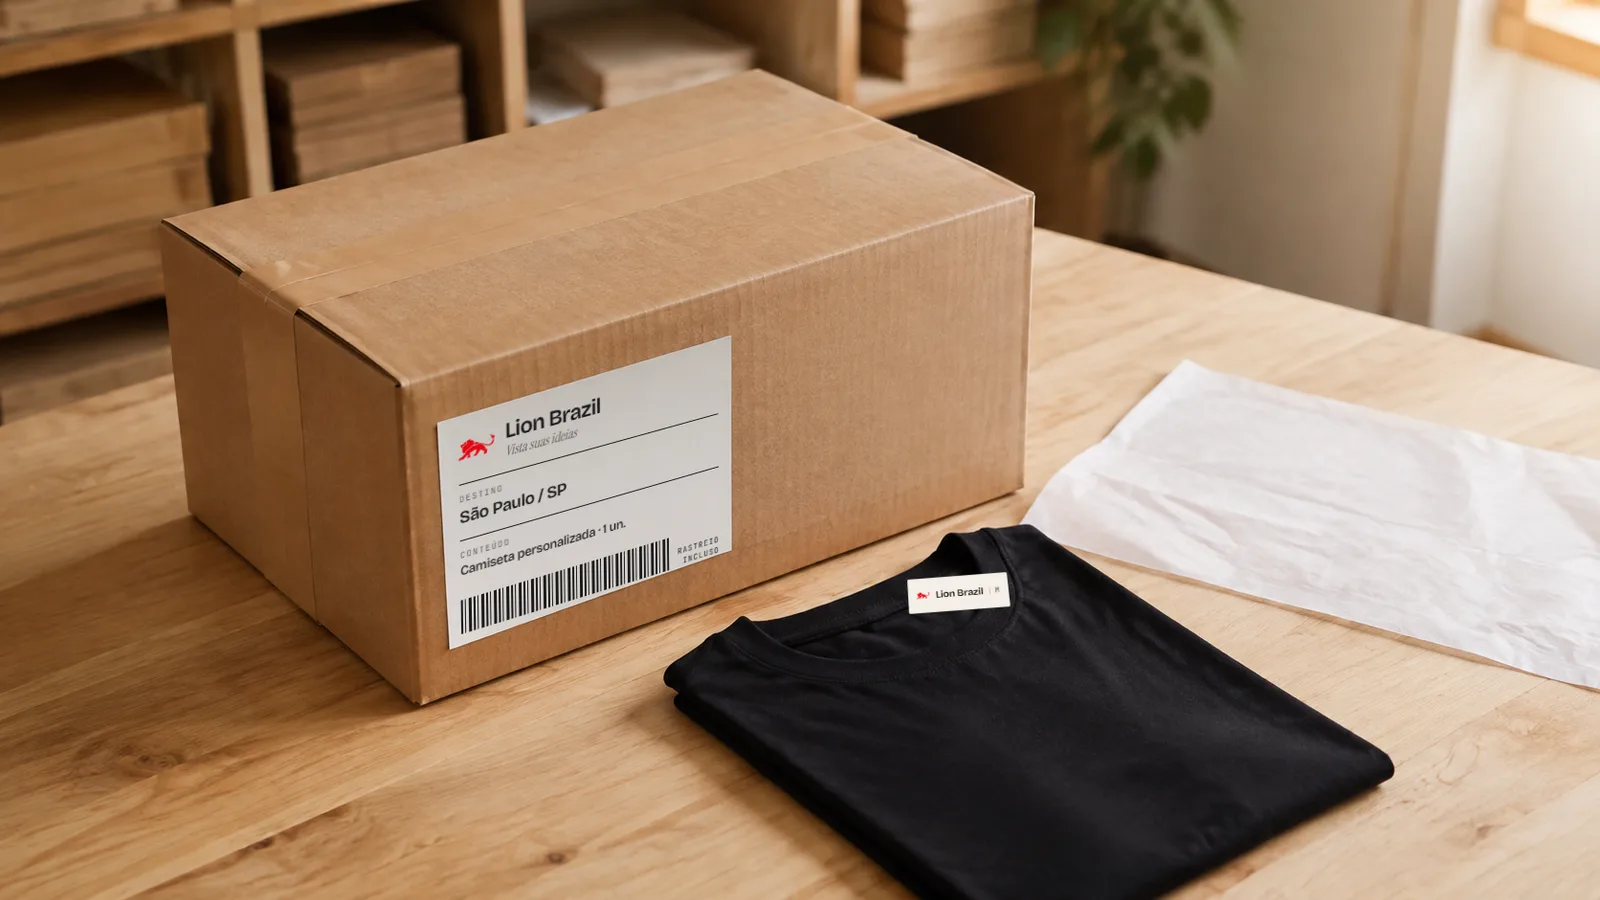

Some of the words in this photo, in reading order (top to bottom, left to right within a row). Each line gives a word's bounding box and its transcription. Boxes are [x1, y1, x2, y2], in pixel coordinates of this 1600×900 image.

[505, 415, 545, 438] Lion
[550, 397, 601, 427] Brazil
[506, 440, 529, 456] Vista
[529, 435, 550, 449] suas
[551, 428, 578, 443] ideias
[459, 485, 503, 503] DESTINO
[459, 504, 489, 524] São
[493, 492, 535, 515] Paulo
[546, 482, 568, 500] SP
[460, 551, 515, 576] Camiseta
[517, 527, 596, 561] personalizada
[609, 520, 626, 532] un.
[460, 538, 510, 559] CONTEÚDO
[677, 536, 719, 554] RASTREIO
[683, 547, 719, 563] INCLUSO
[935, 589, 956, 599] Lion
[957, 586, 984, 597] Brazil
